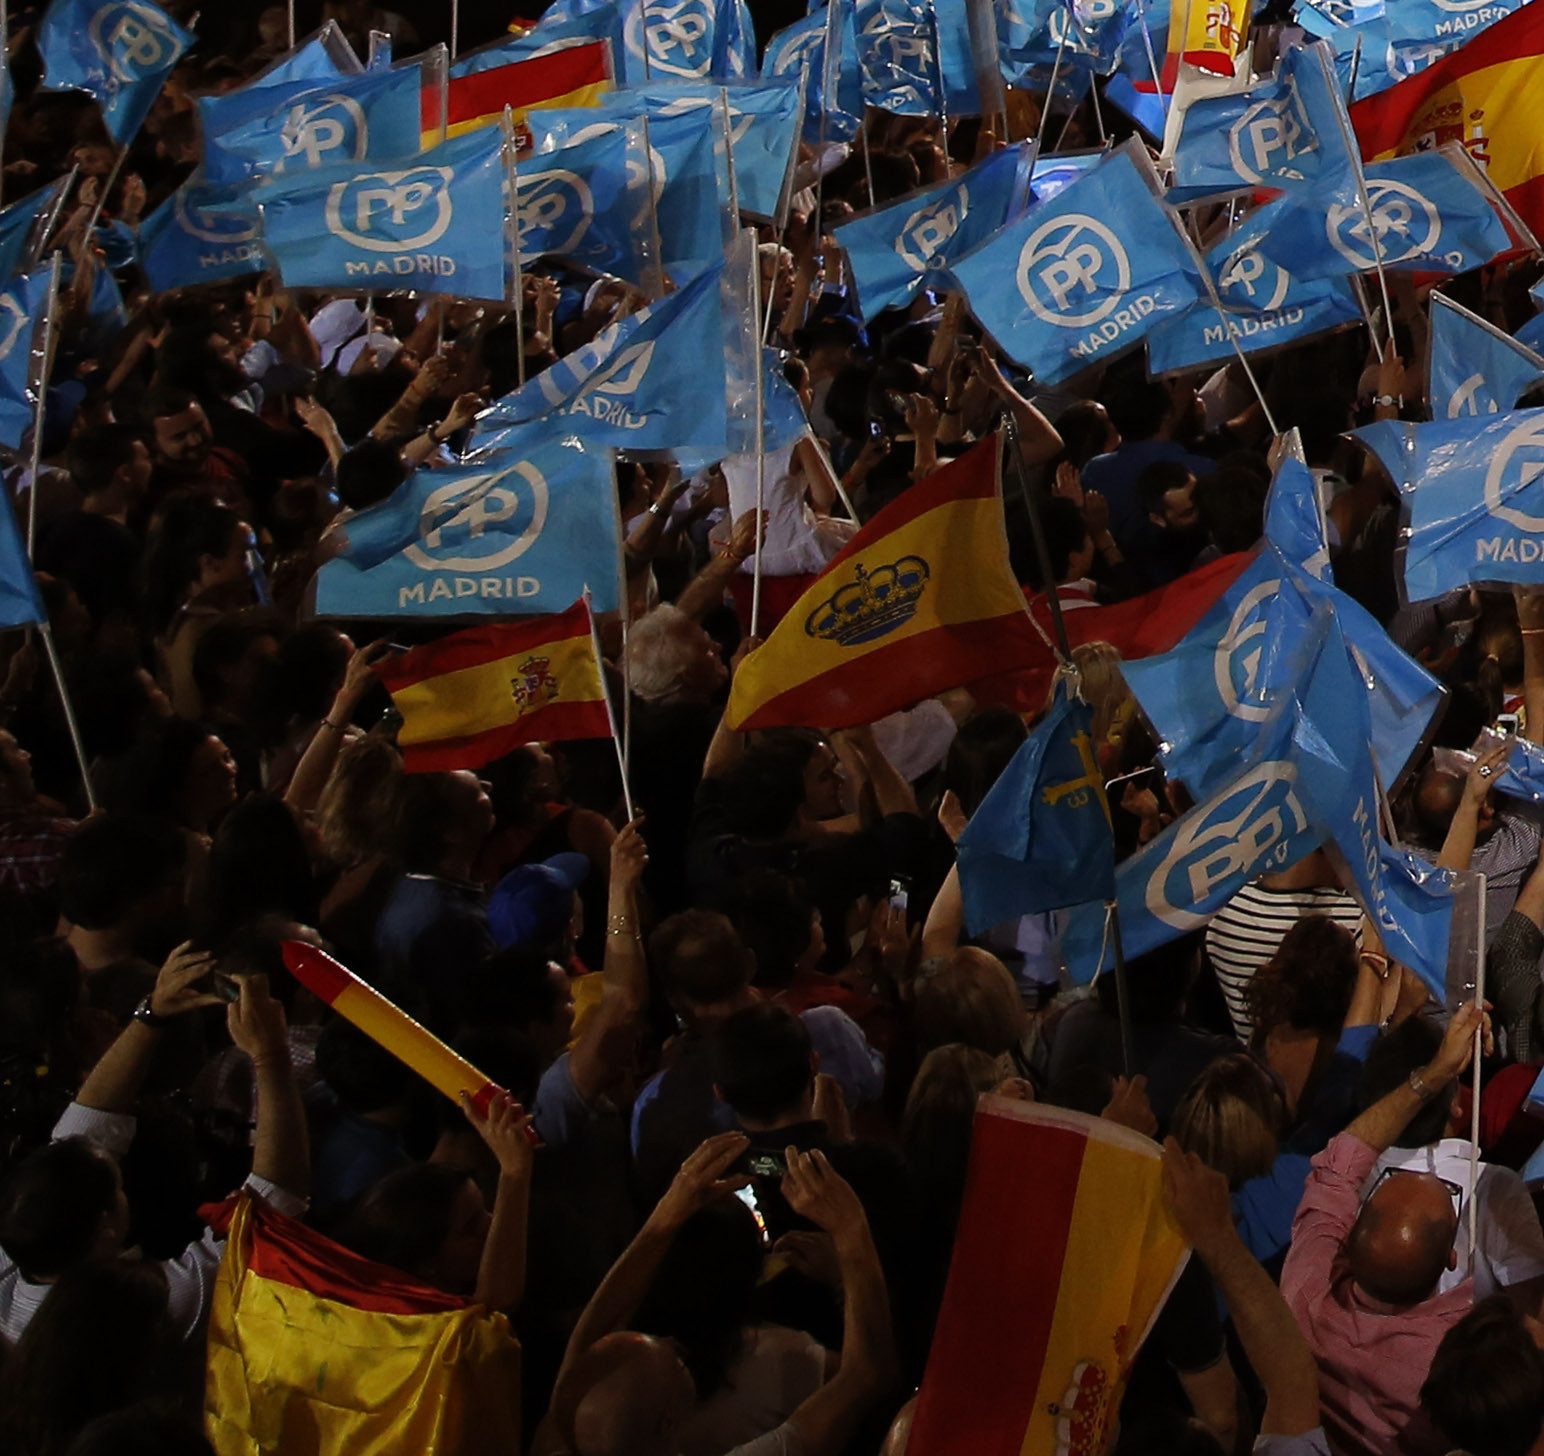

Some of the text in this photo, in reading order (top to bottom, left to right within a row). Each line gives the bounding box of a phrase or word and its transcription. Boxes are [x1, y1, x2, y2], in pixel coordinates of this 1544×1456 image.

[355, 181, 434, 232] PP
[344, 252, 457, 277] MADRID
[1039, 242, 1103, 312] PP
[1068, 294, 1156, 359] MADRID
[1203, 308, 1305, 346] MADRID
[398, 575, 541, 610] MADRID
